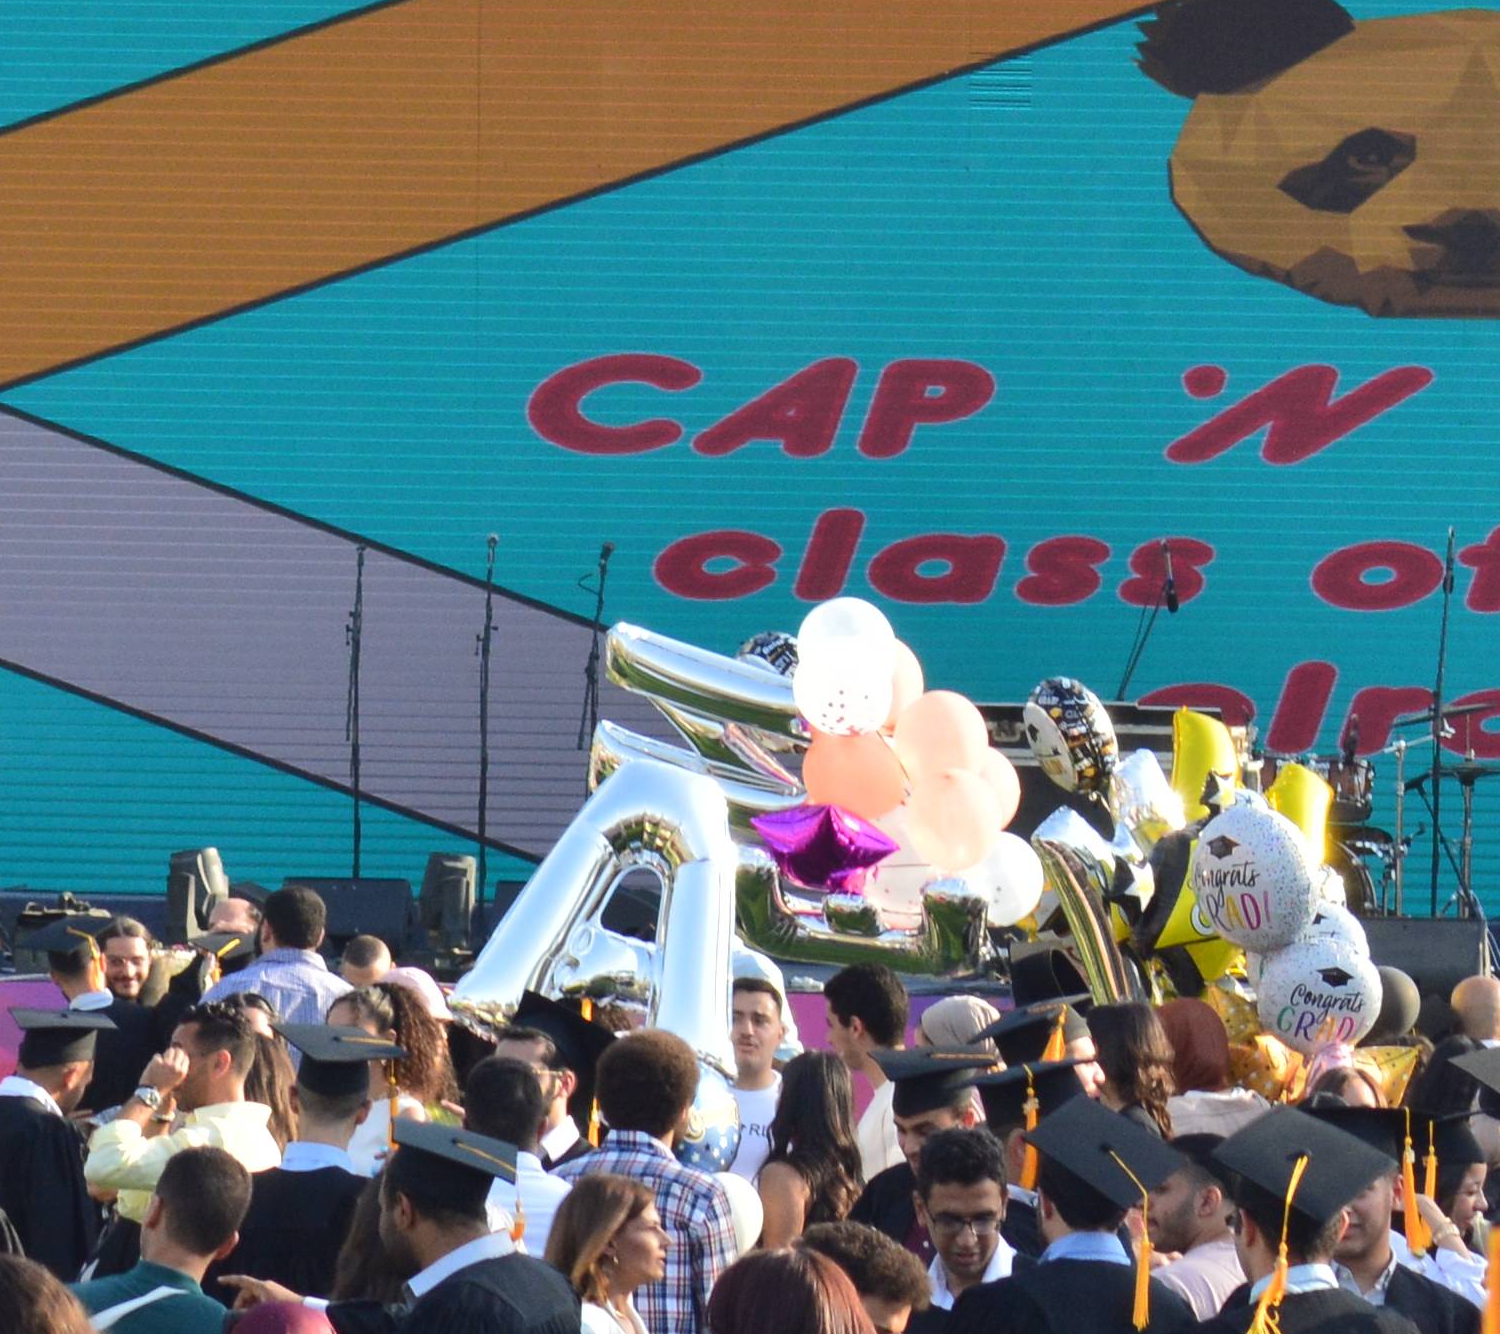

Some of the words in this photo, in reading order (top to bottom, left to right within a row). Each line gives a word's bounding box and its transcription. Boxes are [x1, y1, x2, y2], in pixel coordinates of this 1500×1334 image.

[527, 353, 996, 458] CAP
[654, 508, 1216, 607] class
[1204, 890, 1271, 933] RAD!
[1289, 982, 1366, 1025] Congrats
